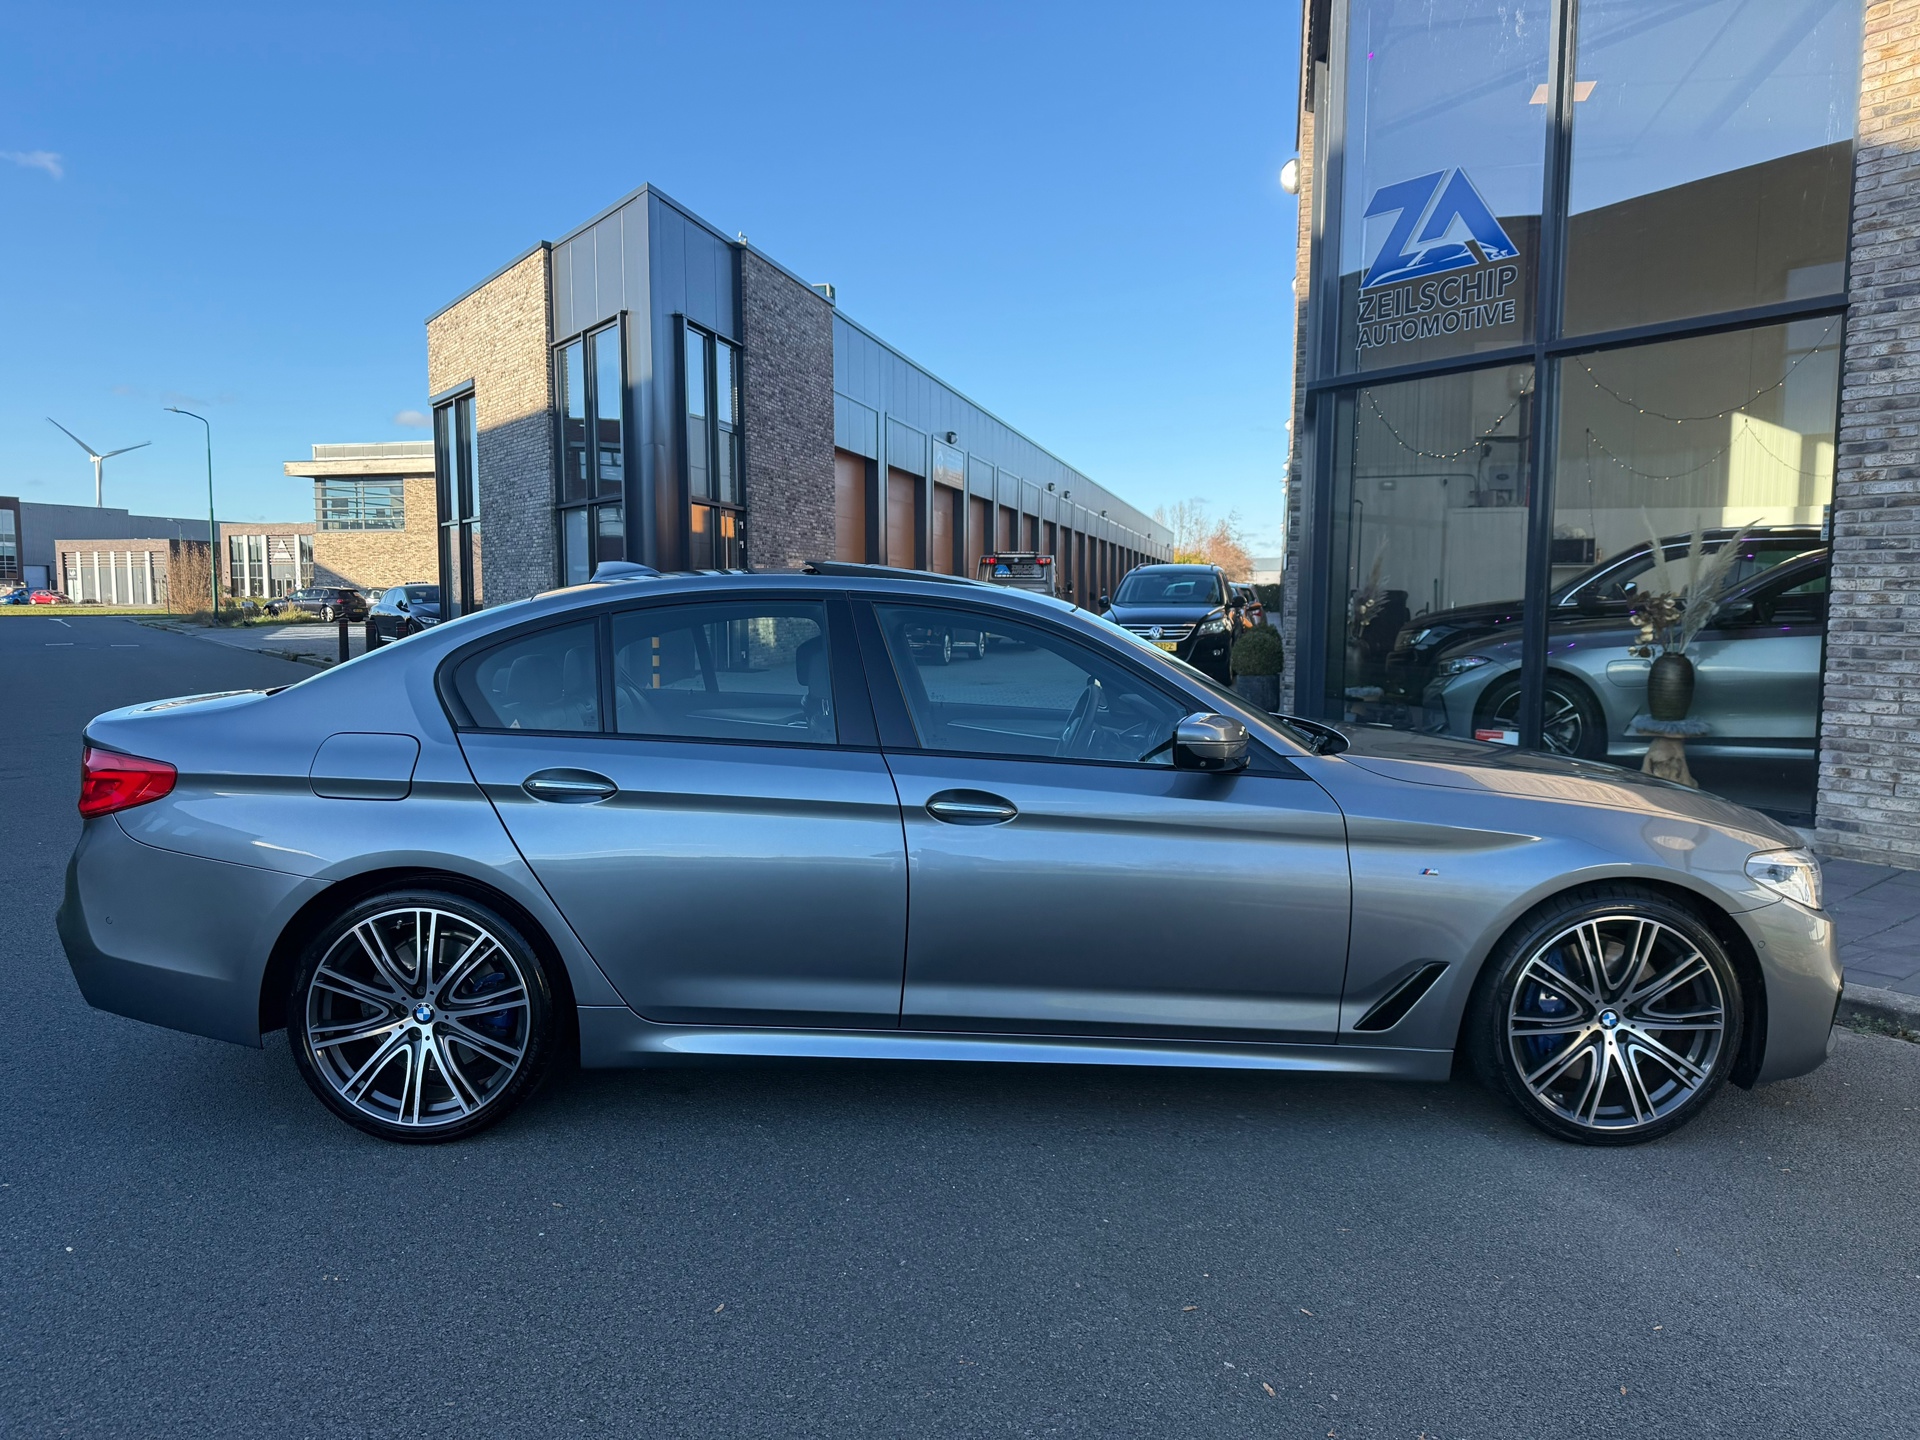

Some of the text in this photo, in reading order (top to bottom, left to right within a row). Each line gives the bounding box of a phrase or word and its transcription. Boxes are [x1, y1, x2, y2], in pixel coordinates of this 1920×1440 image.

[1359, 165, 1520, 289] ZA
[1356, 299, 1515, 350] AUTOMOTIVE
[1357, 265, 1518, 325] ZEILSCHIP
